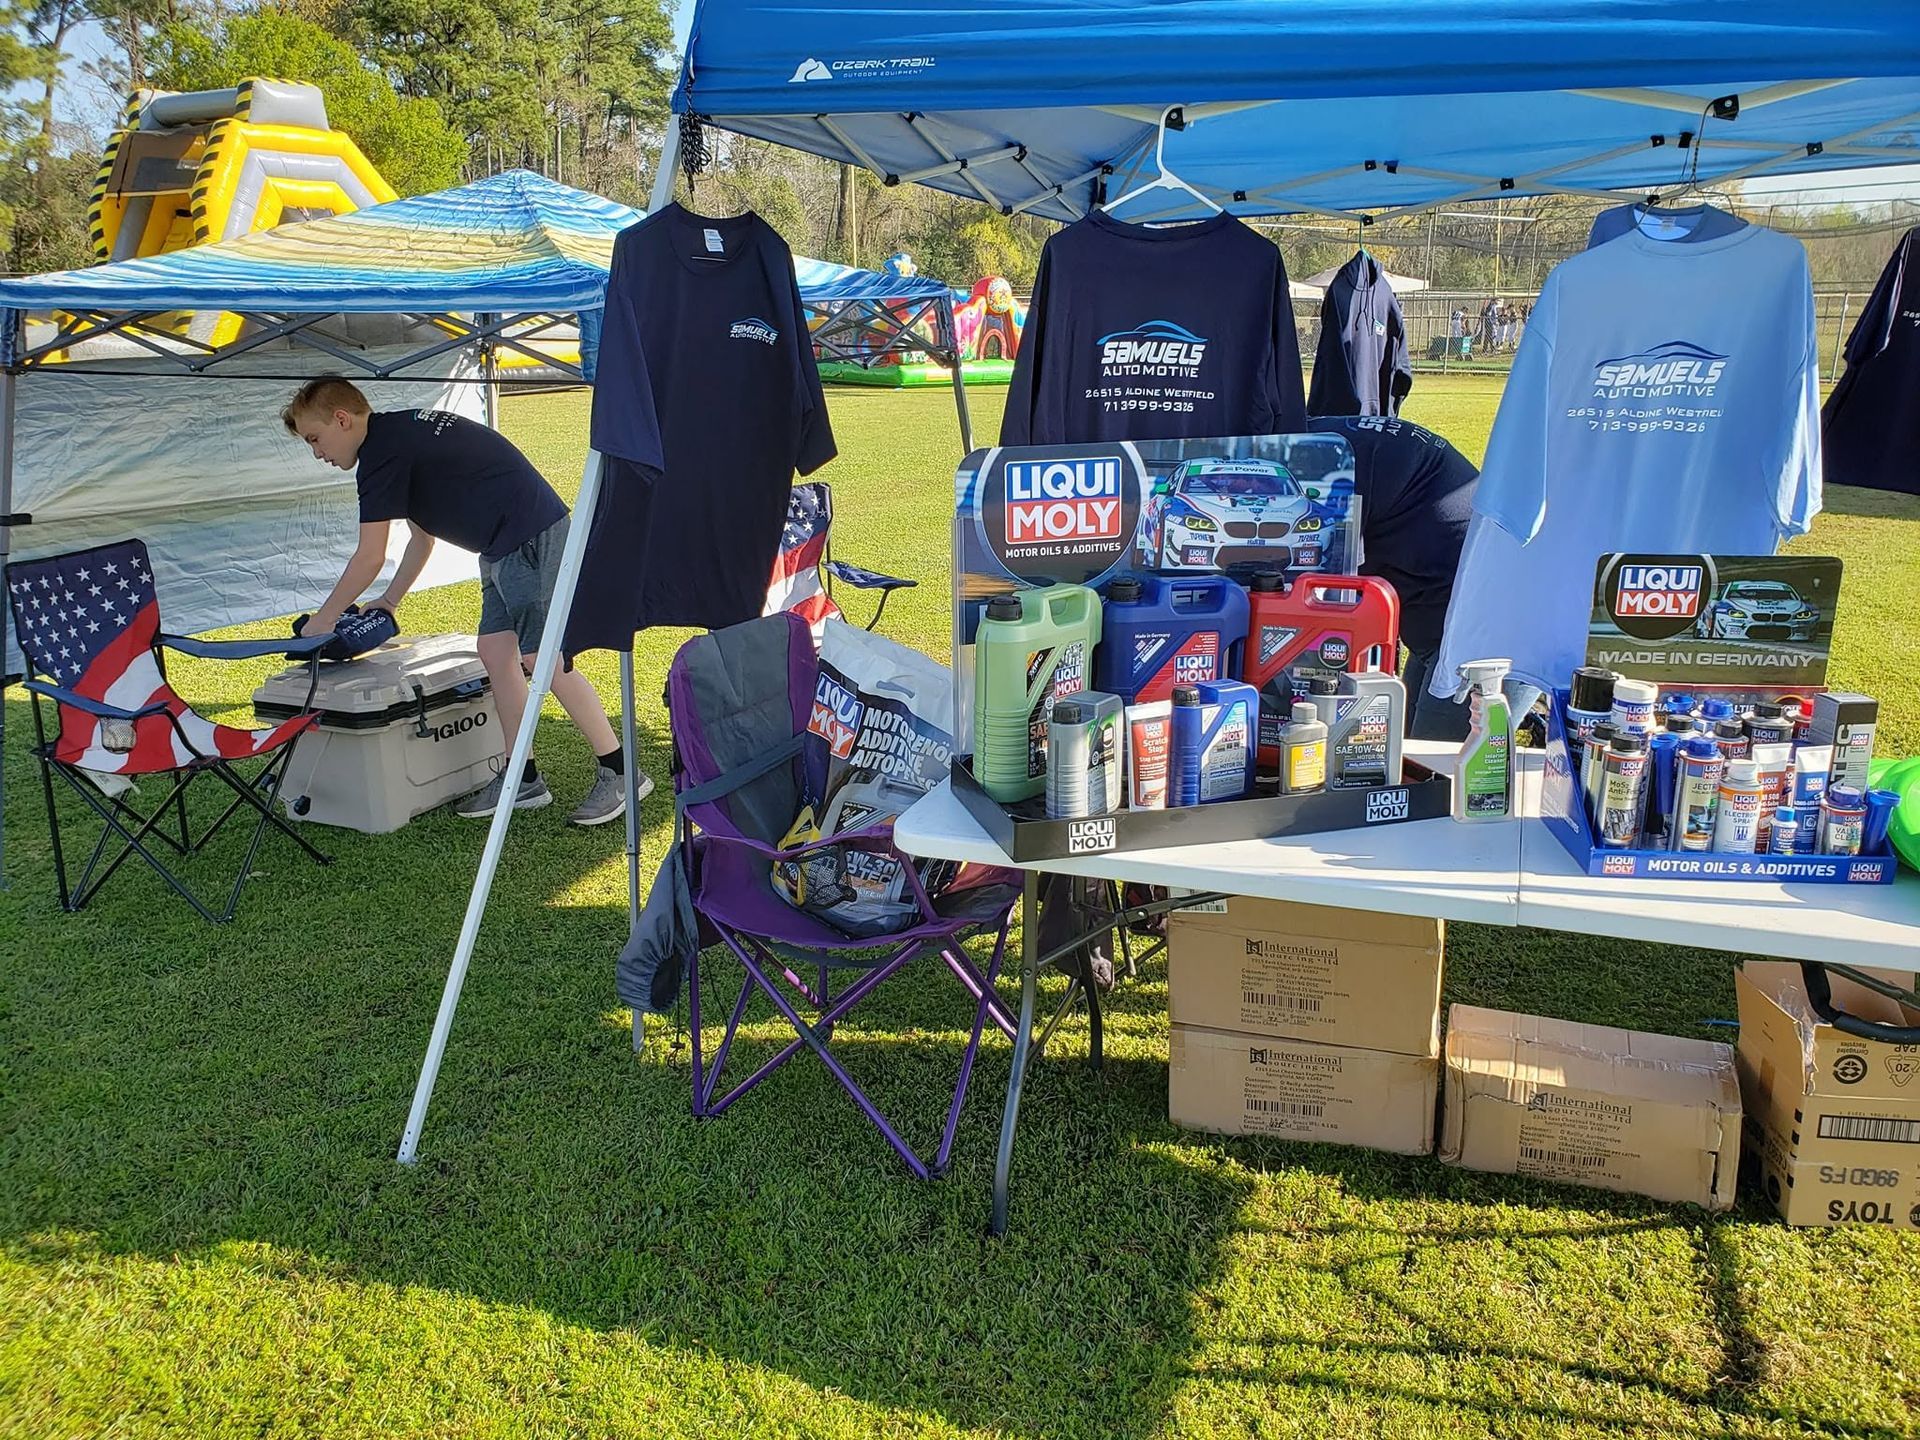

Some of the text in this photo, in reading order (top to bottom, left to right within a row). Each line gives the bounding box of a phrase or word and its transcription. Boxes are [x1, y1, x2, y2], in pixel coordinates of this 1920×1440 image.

[832, 57, 934, 71] OZARK TRAIL
[880, 69, 923, 77] EQUIPMENT
[1101, 341, 1206, 366] SAMUELS
[1102, 364, 1199, 378] AUTOMOTIVE
[1594, 361, 1727, 387] SAMUELS
[1085, 387, 1215, 400] 26515 ALDINE WESTFIELD
[1593, 385, 1716, 399] AUTOMOTIVE
[1567, 408, 1615, 418] 26515
[1588, 420, 1706, 433] 713-999-9326
[1235, 466, 1269, 474] Power
[1012, 462, 1115, 500] LIQUI
[1012, 501, 1118, 539] MOLY
[1005, 542, 1121, 559] MOTOR OILS & ADDITIVES
[1623, 568, 1698, 590] LIQUI
[1620, 592, 1696, 614] MOLY
[1324, 643, 1347, 652] LIQUI
[1177, 656, 1213, 669] LIQUI
[1323, 651, 1347, 660] MOLY
[1599, 651, 1815, 667] MADE IN GERMANY
[1056, 666, 1081, 682] LIQUI
[1176, 669, 1213, 682] MOLY
[1056, 679, 1081, 695] MOLY
[434, 711, 488, 742] IGLOO
[1361, 716, 1386, 724] LIQUI
[1360, 725, 1387, 733] MOLY
[1752, 729, 1778, 738] LIQUI
[1335, 744, 1386, 755] SAE 10W-40
[1369, 791, 1406, 806] LIQUI
[1369, 805, 1406, 820] MOLY
[1072, 821, 1113, 836] LIQUI
[1072, 836, 1113, 849] MOLY
[1606, 855, 1635, 865] LIQUI
[1604, 864, 1633, 874] MOLY
[1648, 860, 1836, 877] MOTOR OILS & ADDITIVES
[1852, 863, 1881, 873] LIQUI
[1850, 872, 1879, 881] MOLY
[1265, 941, 1338, 957] International
[1269, 1049, 1342, 1065] International
[1895, 1062, 1911, 1074] 20
[1549, 1093, 1632, 1115] International
[1827, 1200, 1894, 1225] TOYS
